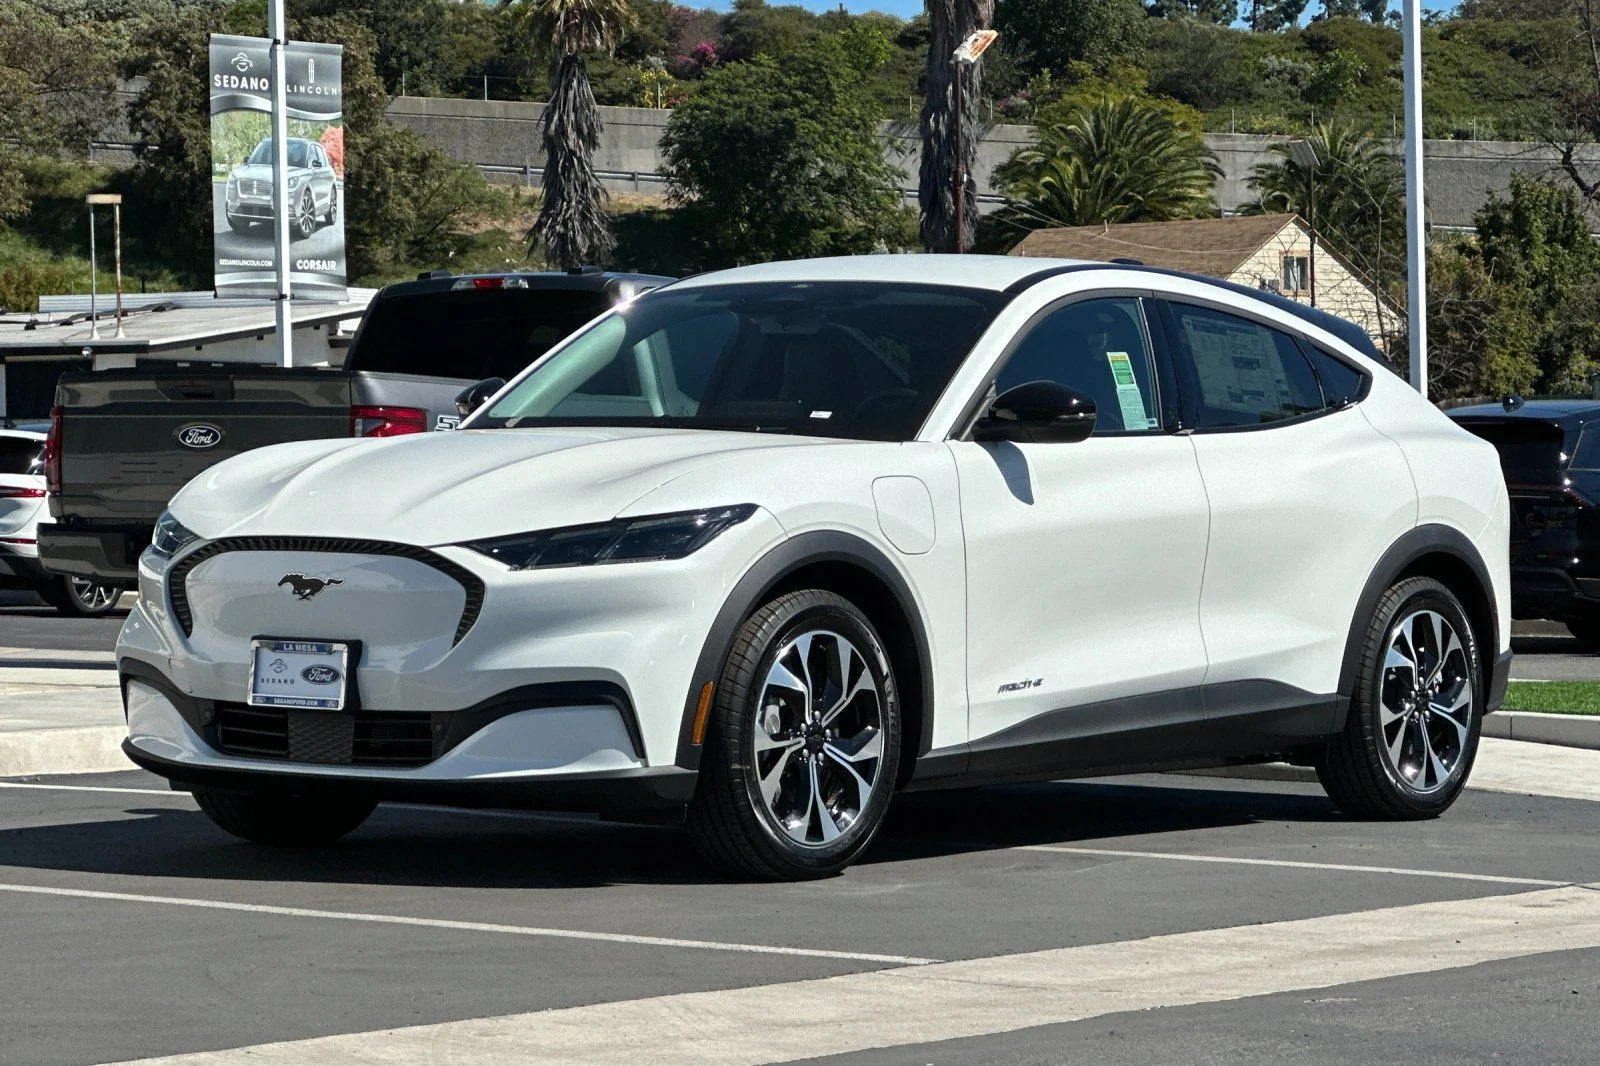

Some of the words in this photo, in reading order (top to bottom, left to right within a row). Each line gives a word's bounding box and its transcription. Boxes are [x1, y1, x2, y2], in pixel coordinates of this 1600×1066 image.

[213, 73, 269, 91] SEDANO
[286, 85, 338, 96] LINCOLN
[296, 259, 337, 271] CORSAIR
[185, 428, 214, 444] Ford
[283, 643, 294, 651] LA
[295, 644, 317, 652] MESA
[307, 666, 335, 683] Ford
